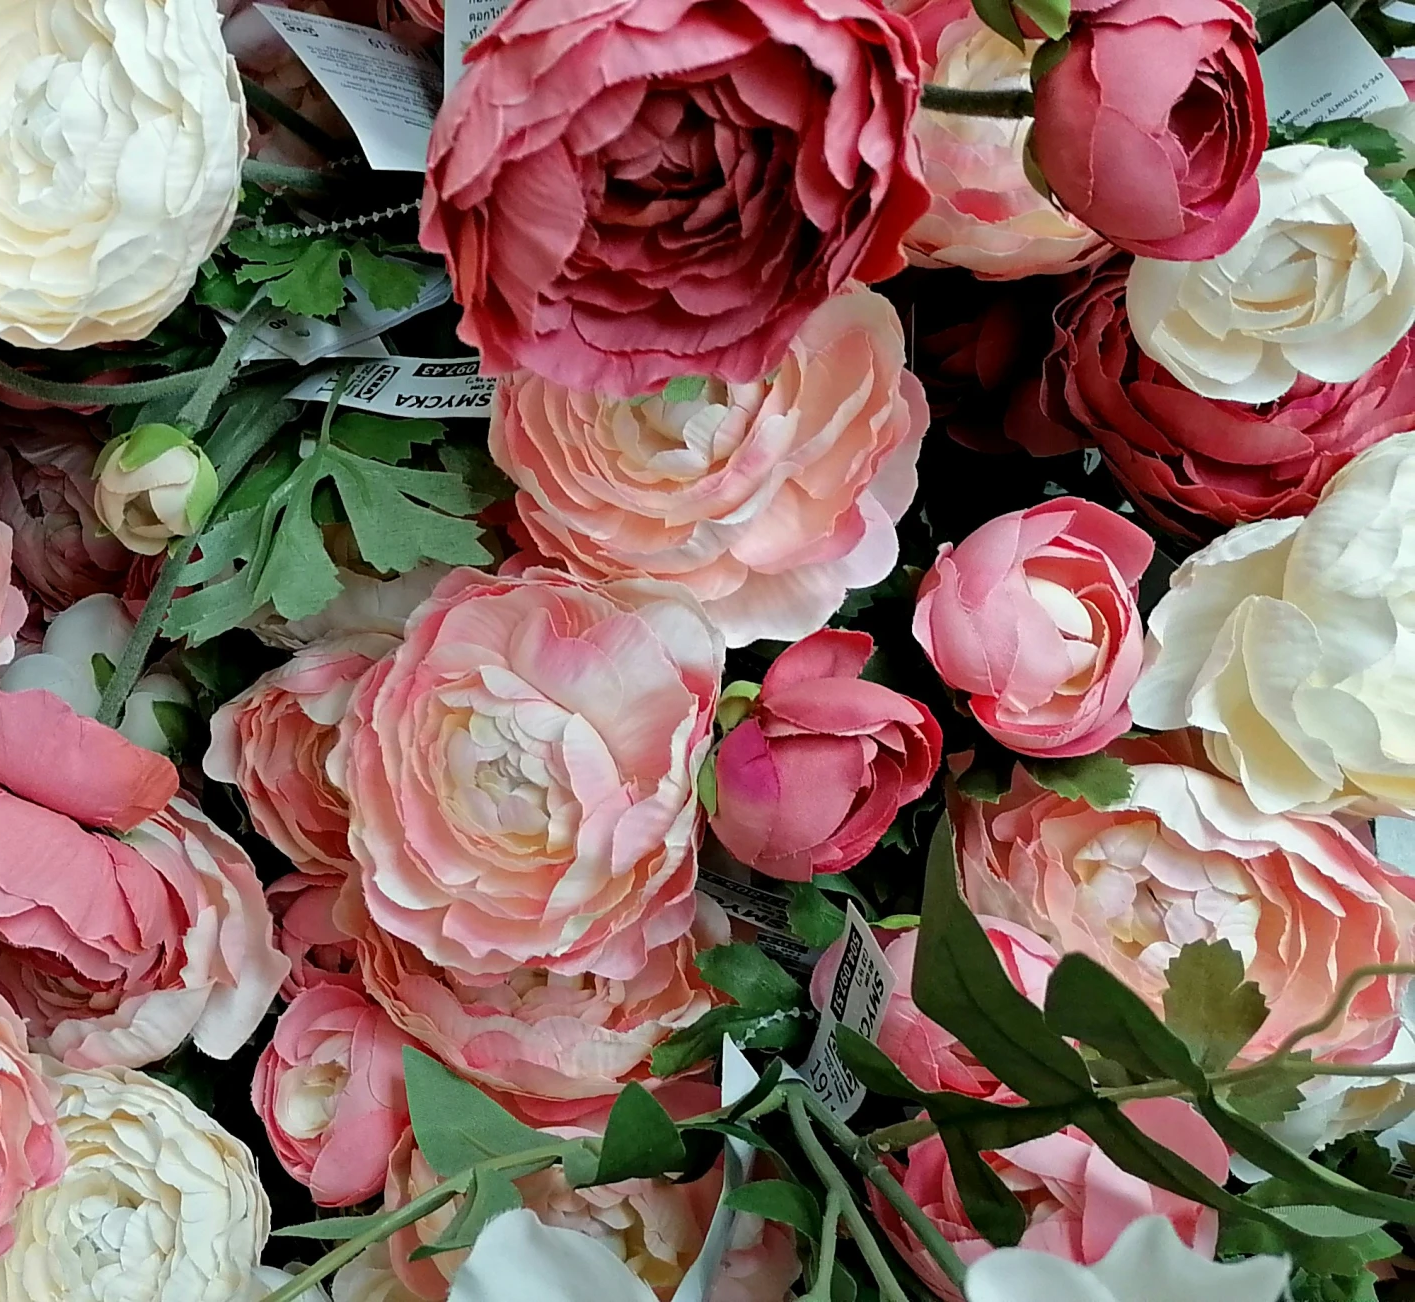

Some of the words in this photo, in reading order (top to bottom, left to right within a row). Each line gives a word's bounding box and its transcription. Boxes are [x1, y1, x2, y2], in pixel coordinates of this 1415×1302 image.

[394, 393, 492, 408] SMYCKA
[833, 930, 862, 1016] 504.097.51
[858, 971, 884, 1040] SMYC
